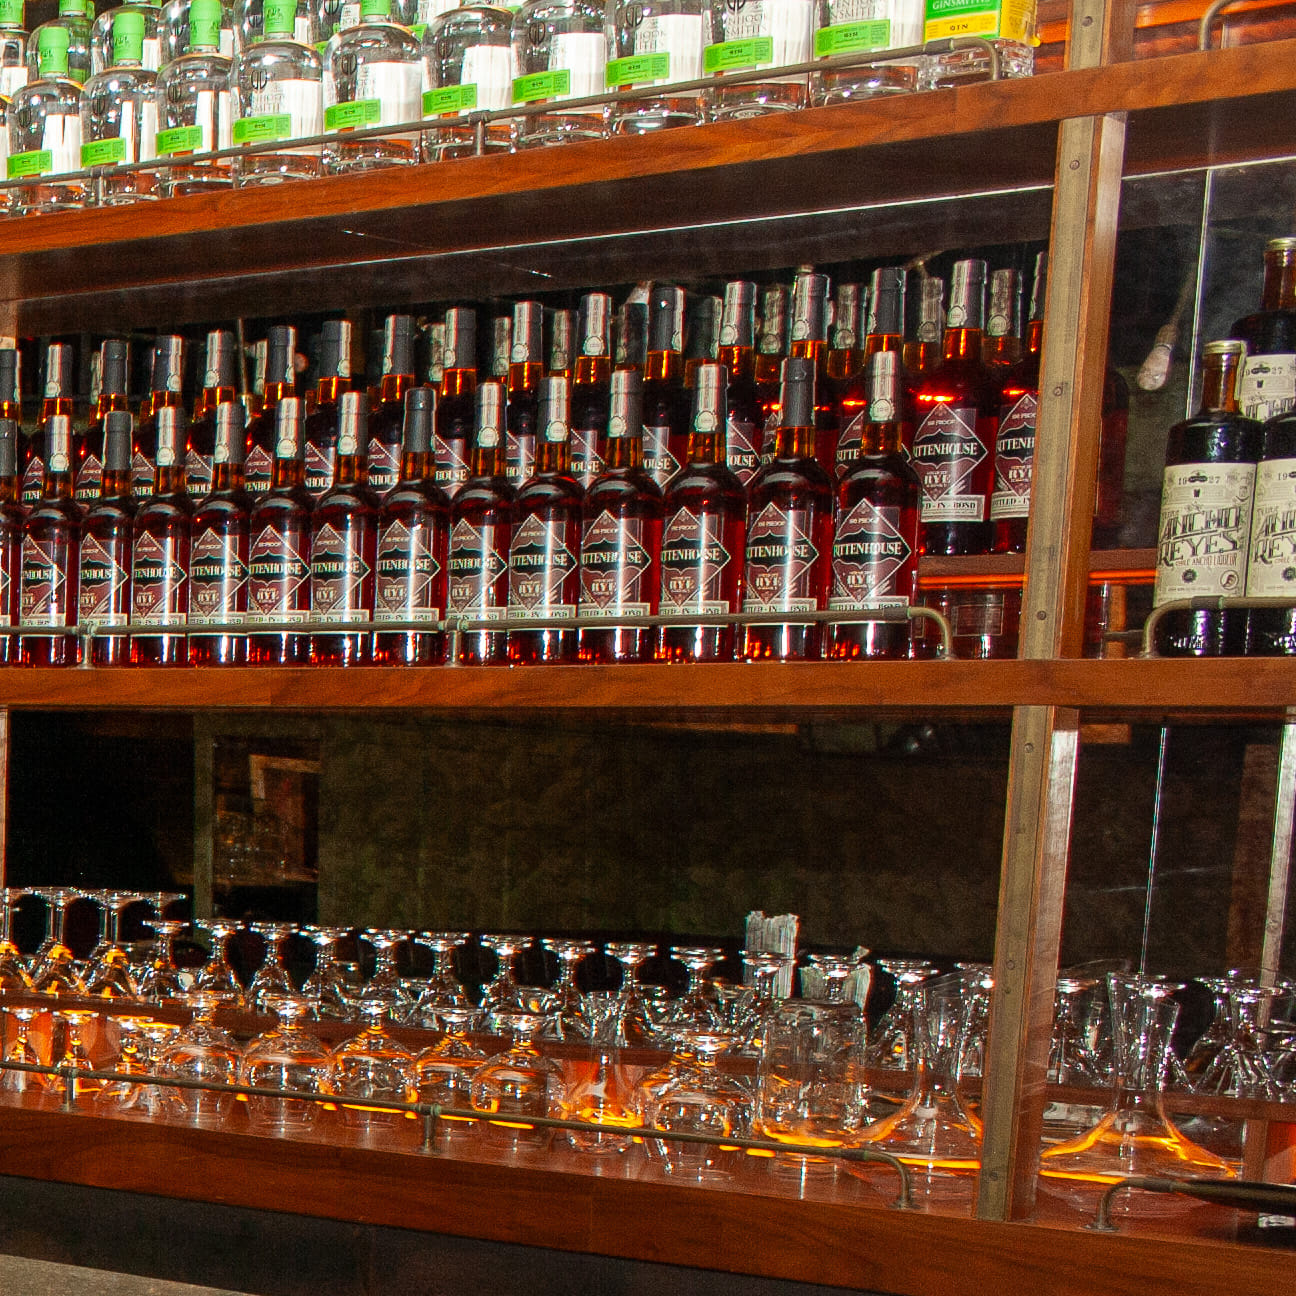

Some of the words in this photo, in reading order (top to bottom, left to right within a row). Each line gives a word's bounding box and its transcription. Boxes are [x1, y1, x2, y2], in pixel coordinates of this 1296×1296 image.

[932, 0, 991, 10] GINSM
[998, 437, 1035, 451] ITTENH
[1161, 507, 1240, 540] ANCHO
[662, 549, 720, 562] ITTENHOSE
[833, 542, 902, 558] RITTENHOUSE
[1157, 533, 1240, 566] REYES
[191, 566, 241, 578] TTENHOUSE
[251, 562, 301, 576] TTENHOUSE
[378, 559, 430, 572] TTENHOUSE
